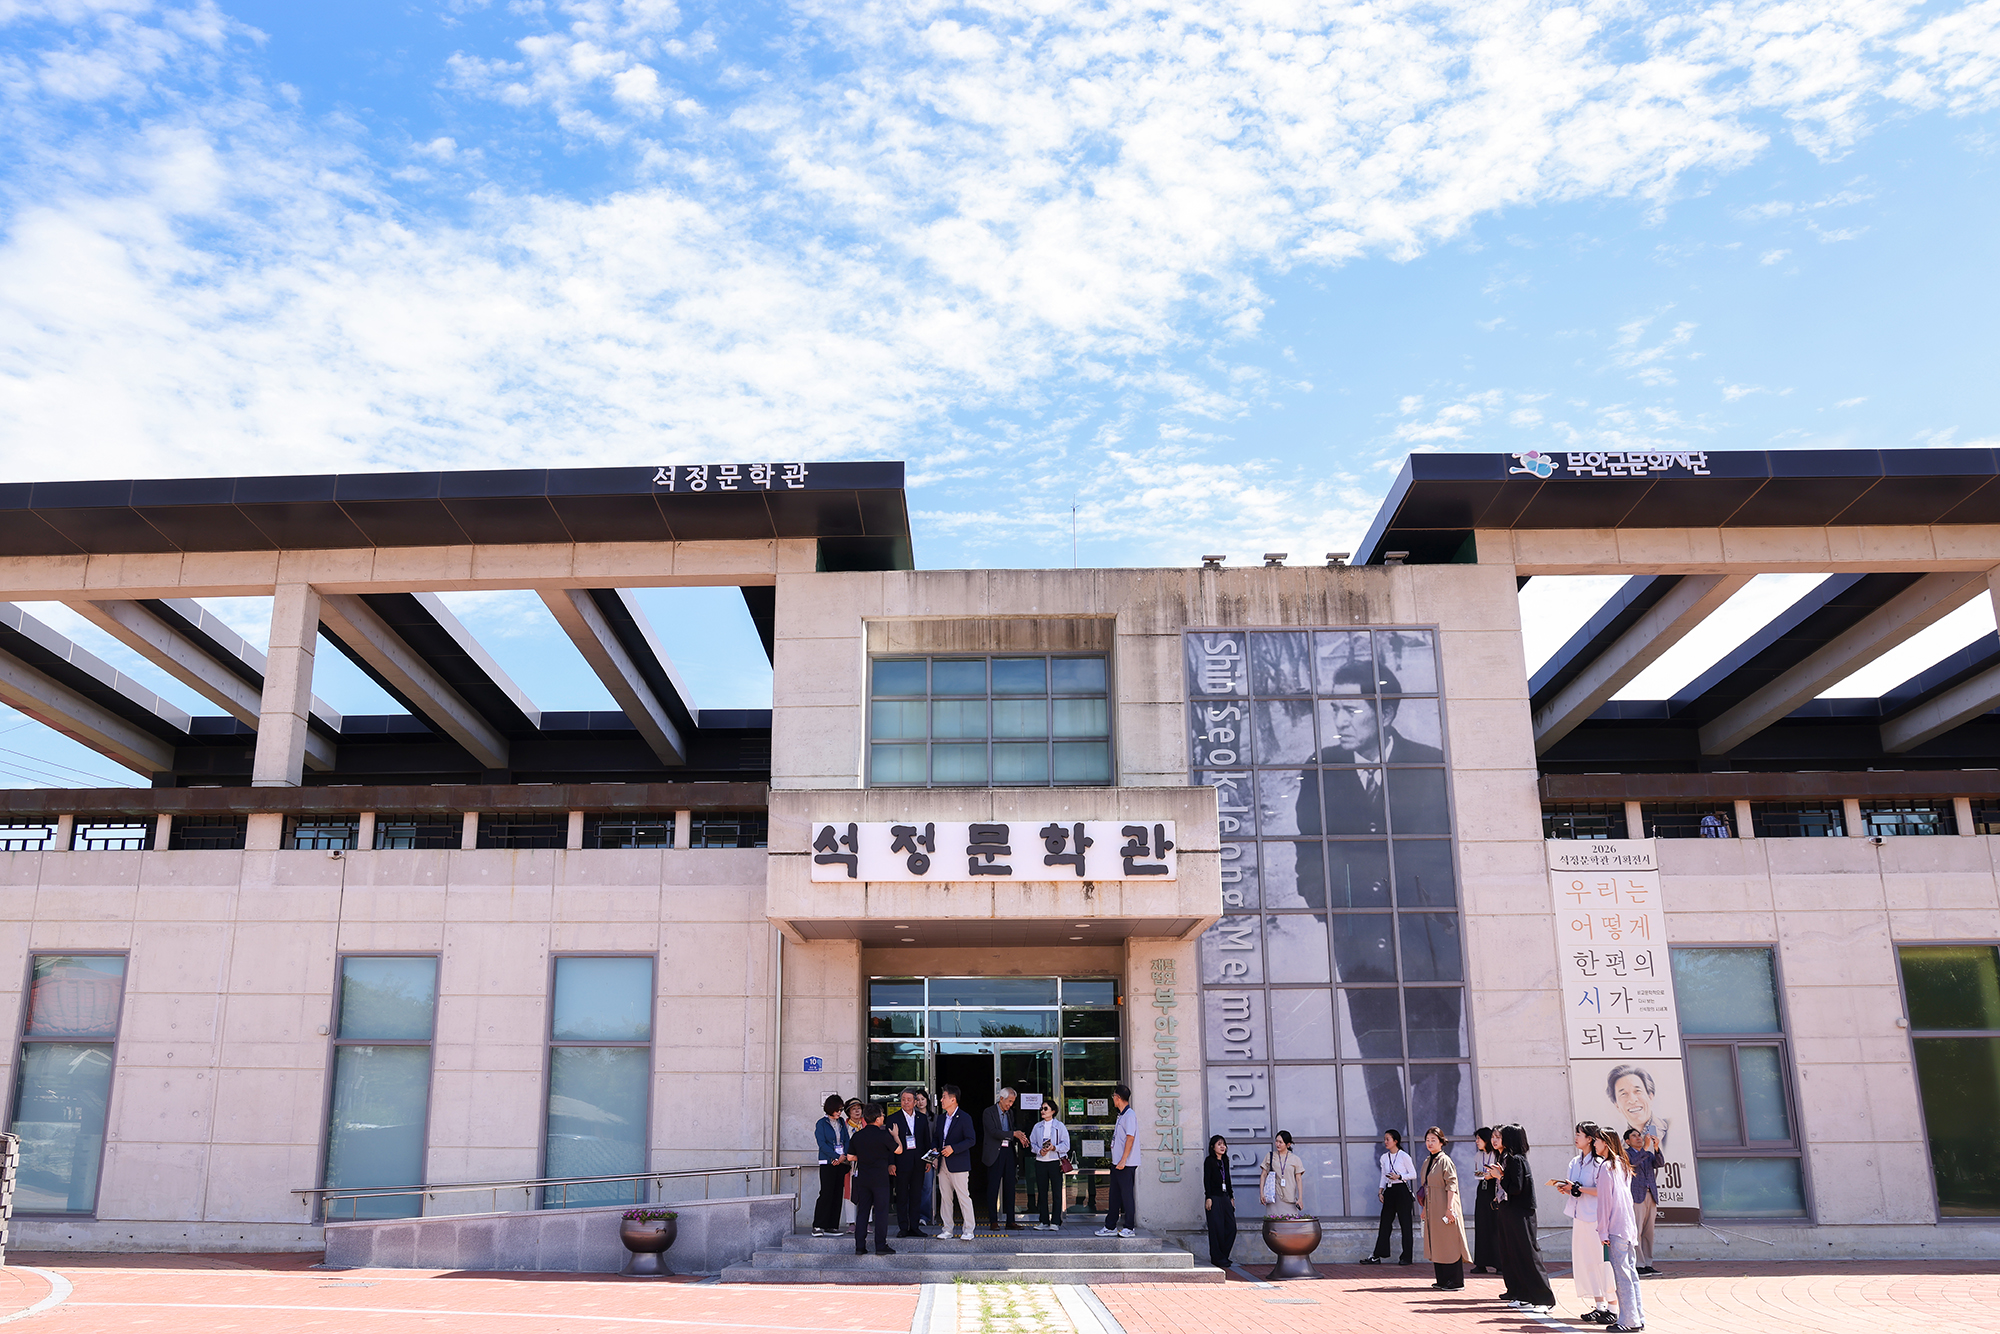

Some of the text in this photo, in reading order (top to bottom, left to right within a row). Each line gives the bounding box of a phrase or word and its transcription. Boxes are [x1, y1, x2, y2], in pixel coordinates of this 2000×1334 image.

[1567, 448, 1711, 477] 부안군문화재단
[652, 462, 809, 492] 석정문학관
[1204, 639, 1241, 694] Shin
[813, 822, 1175, 879] 석정문학관
[1560, 854, 1651, 866] 석정문학관 기획전시
[1591, 844, 1617, 854] 2026
[1565, 877, 1649, 905] 우리는
[1571, 913, 1651, 940] 어떻게
[1151, 958, 1176, 972] 재단
[1573, 949, 1655, 977] 한편의
[1151, 972, 1177, 986] 법인
[1578, 986, 1634, 1014] 시가
[1219, 926, 1265, 1109] Memorial
[1581, 1023, 1666, 1052] 되는가
[809, 1058, 817, 1066] 10
[1152, 987, 1185, 1184] 부안군문화재단
